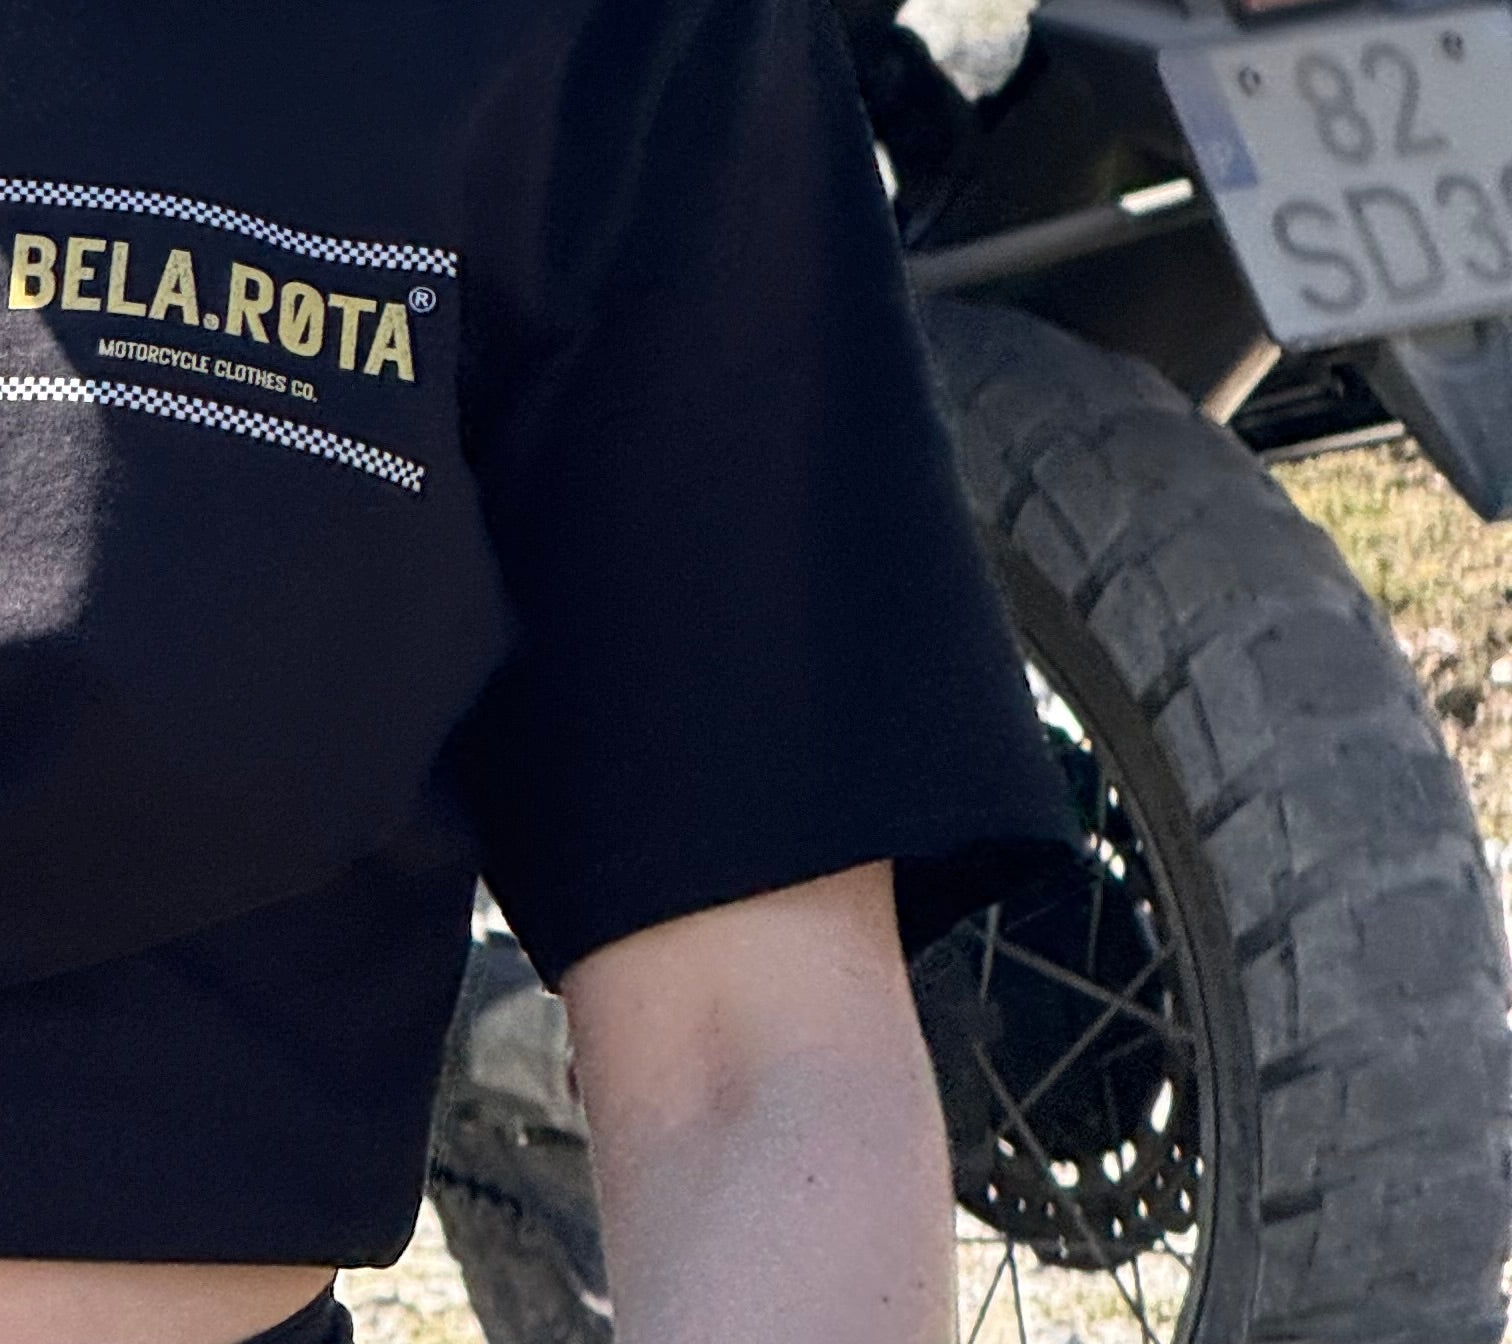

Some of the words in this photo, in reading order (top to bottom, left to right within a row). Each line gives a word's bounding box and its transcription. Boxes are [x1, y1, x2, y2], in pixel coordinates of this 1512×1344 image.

[1293, 42, 1451, 166] 82
[97, 338, 211, 374] MOTORCYCLE
[213, 359, 287, 394] CLOTHES
[290, 378, 319, 403] CO.
